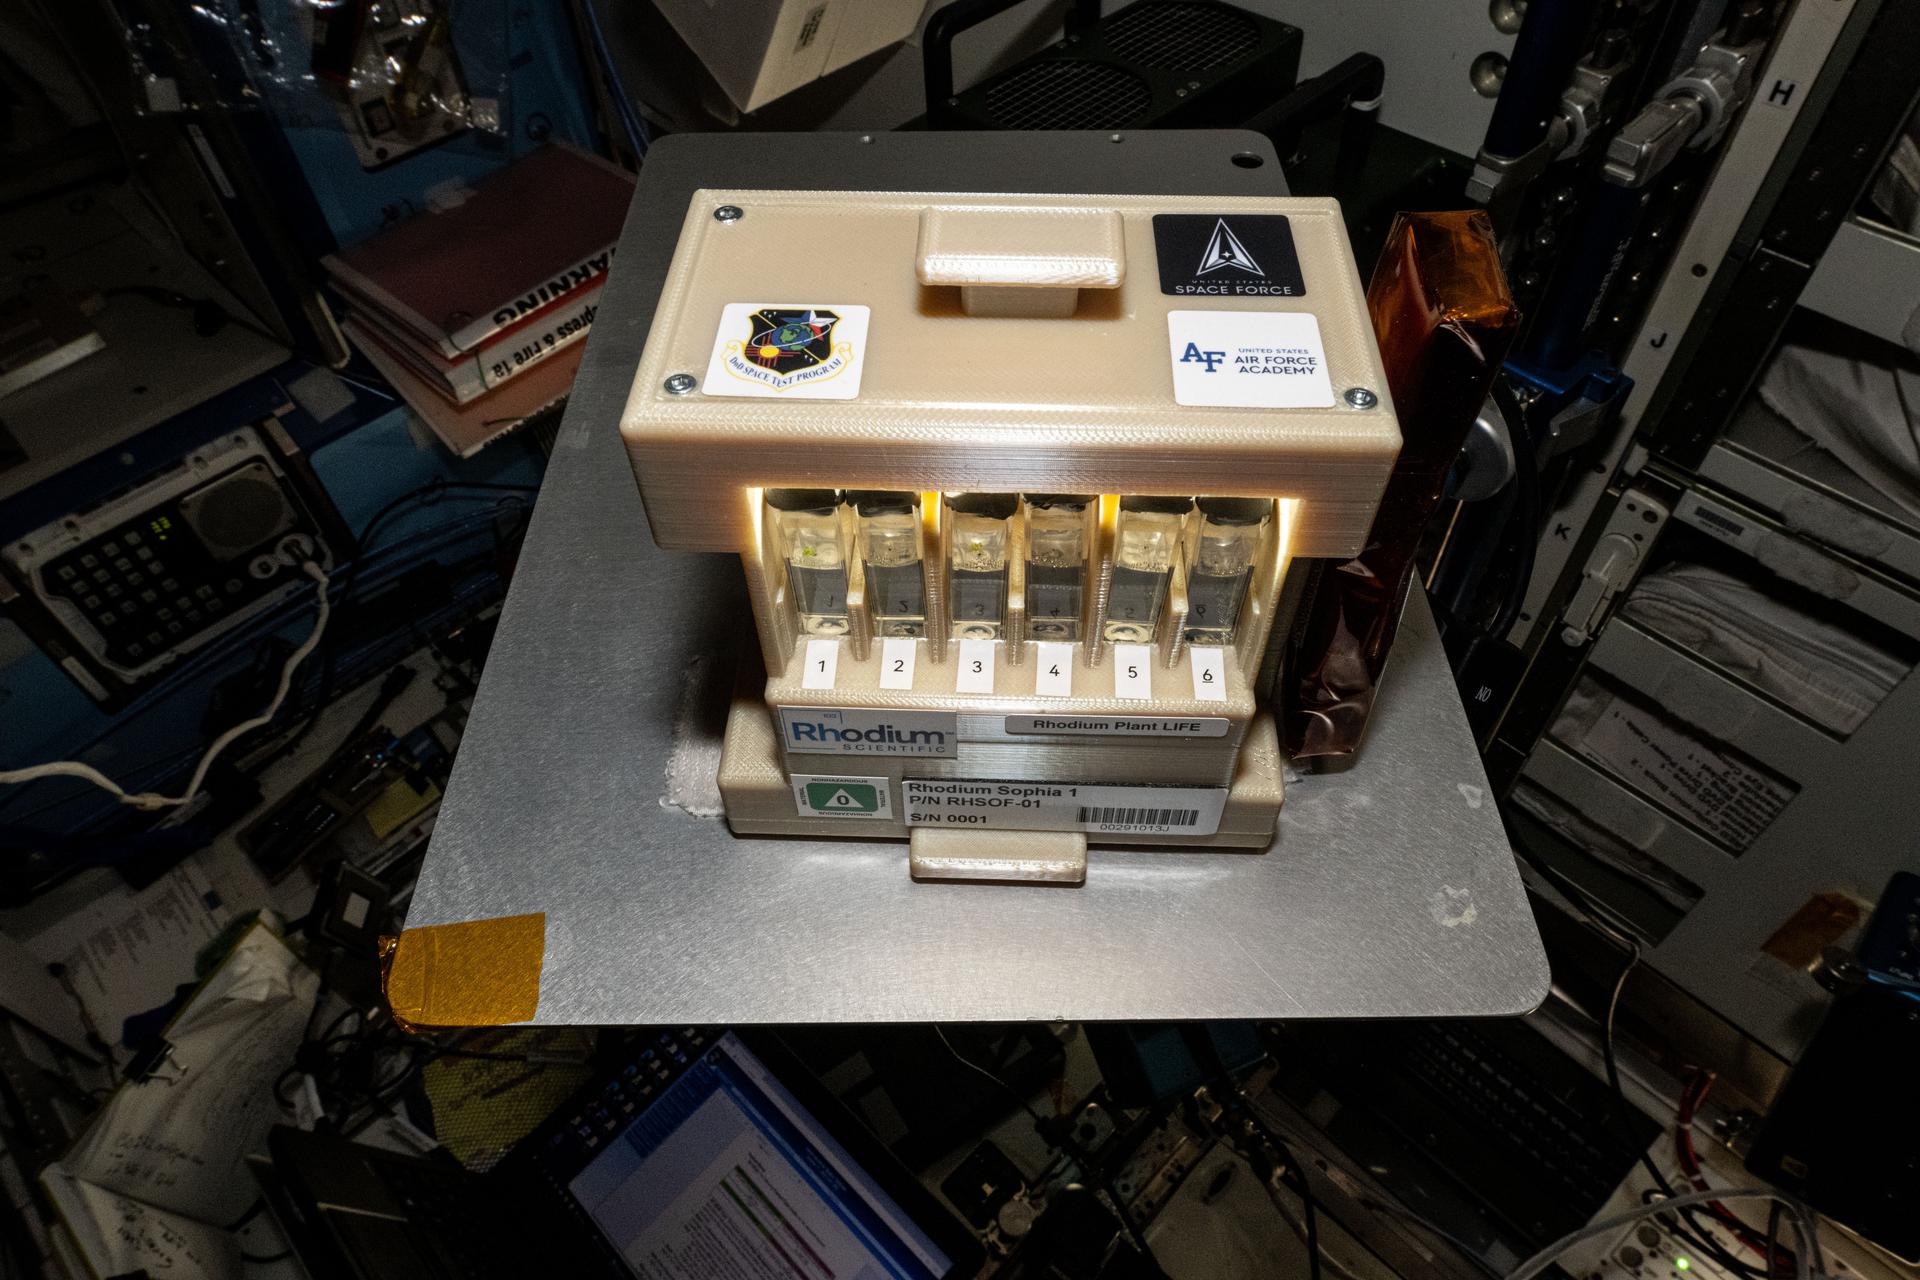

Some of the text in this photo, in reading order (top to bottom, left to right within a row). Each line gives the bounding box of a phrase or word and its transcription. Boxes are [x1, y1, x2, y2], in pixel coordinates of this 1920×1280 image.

[1769, 80, 1795, 106] H
[493, 247, 617, 324] ARNING
[1175, 285, 1292, 295] SPACE FORCE
[557, 305, 598, 339] press
[1651, 333, 1667, 348] J
[1180, 342, 1226, 373] AF
[1234, 356, 1317, 366] AIR FORCE
[743, 366, 769, 382] SPACE
[772, 376, 794, 388] TEST
[796, 358, 843, 382] PROGRAM
[1238, 366, 1316, 375] ACADEMY
[1555, 523, 1571, 540] K
[818, 660, 826, 672] 1
[894, 660, 904, 672] 2
[972, 660, 982, 673] 3
[1049, 664, 1060, 677] 4
[1128, 666, 1138, 678] 5
[1202, 668, 1213, 682] 6
[1033, 720, 1201, 732] Rhodium Plant LIFE
[792, 722, 945, 745] Rhodium
[842, 744, 946, 753] SCIENTIFIC
[908, 783, 1078, 798] Rhodium Sophia 1
[836, 795, 850, 806] 0
[909, 796, 1041, 808] P/N RHSOF-01
[910, 813, 988, 824] S/N 0001
